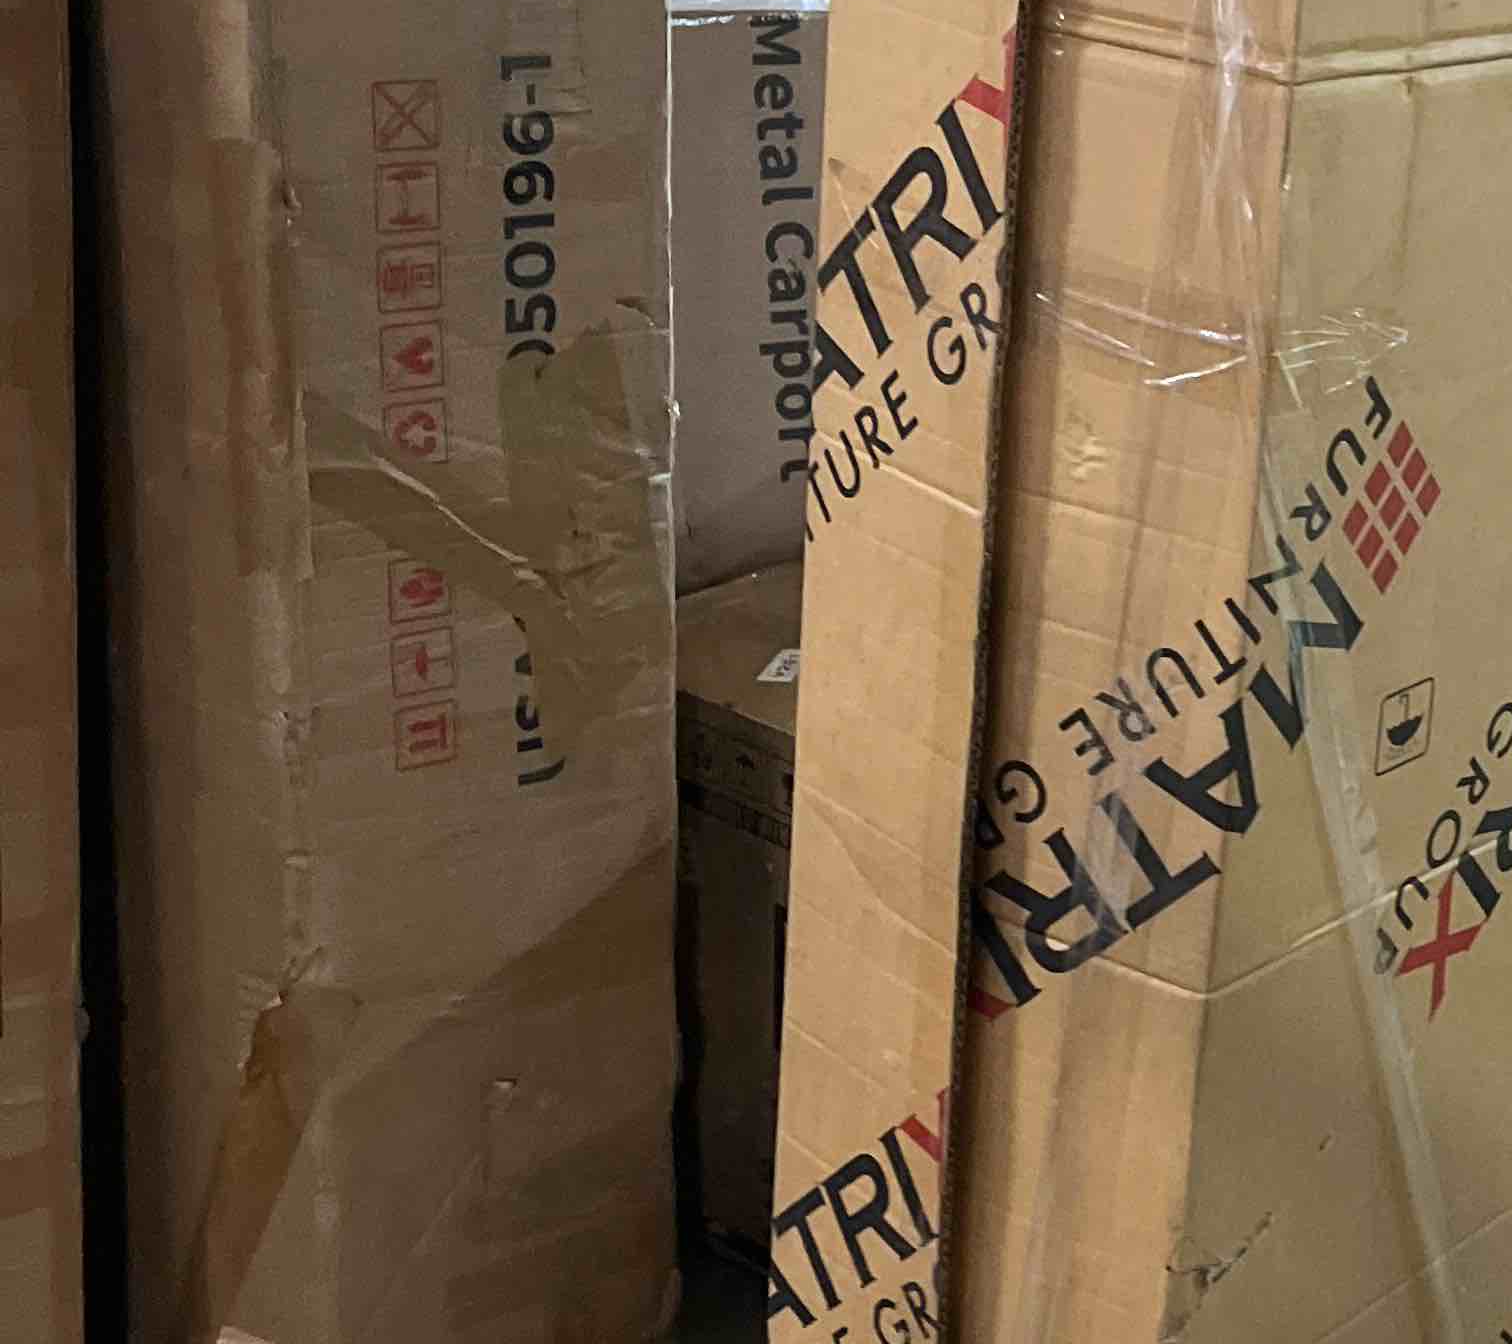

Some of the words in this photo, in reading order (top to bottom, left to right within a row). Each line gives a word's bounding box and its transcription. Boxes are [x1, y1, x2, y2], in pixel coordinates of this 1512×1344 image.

[750, 12, 813, 205] Metal
[757, 222, 815, 484] Carport
[806, 369, 918, 530] TURE
[1058, 375, 1393, 778] FURNITURE
[966, 561, 1364, 1022] MATRI
